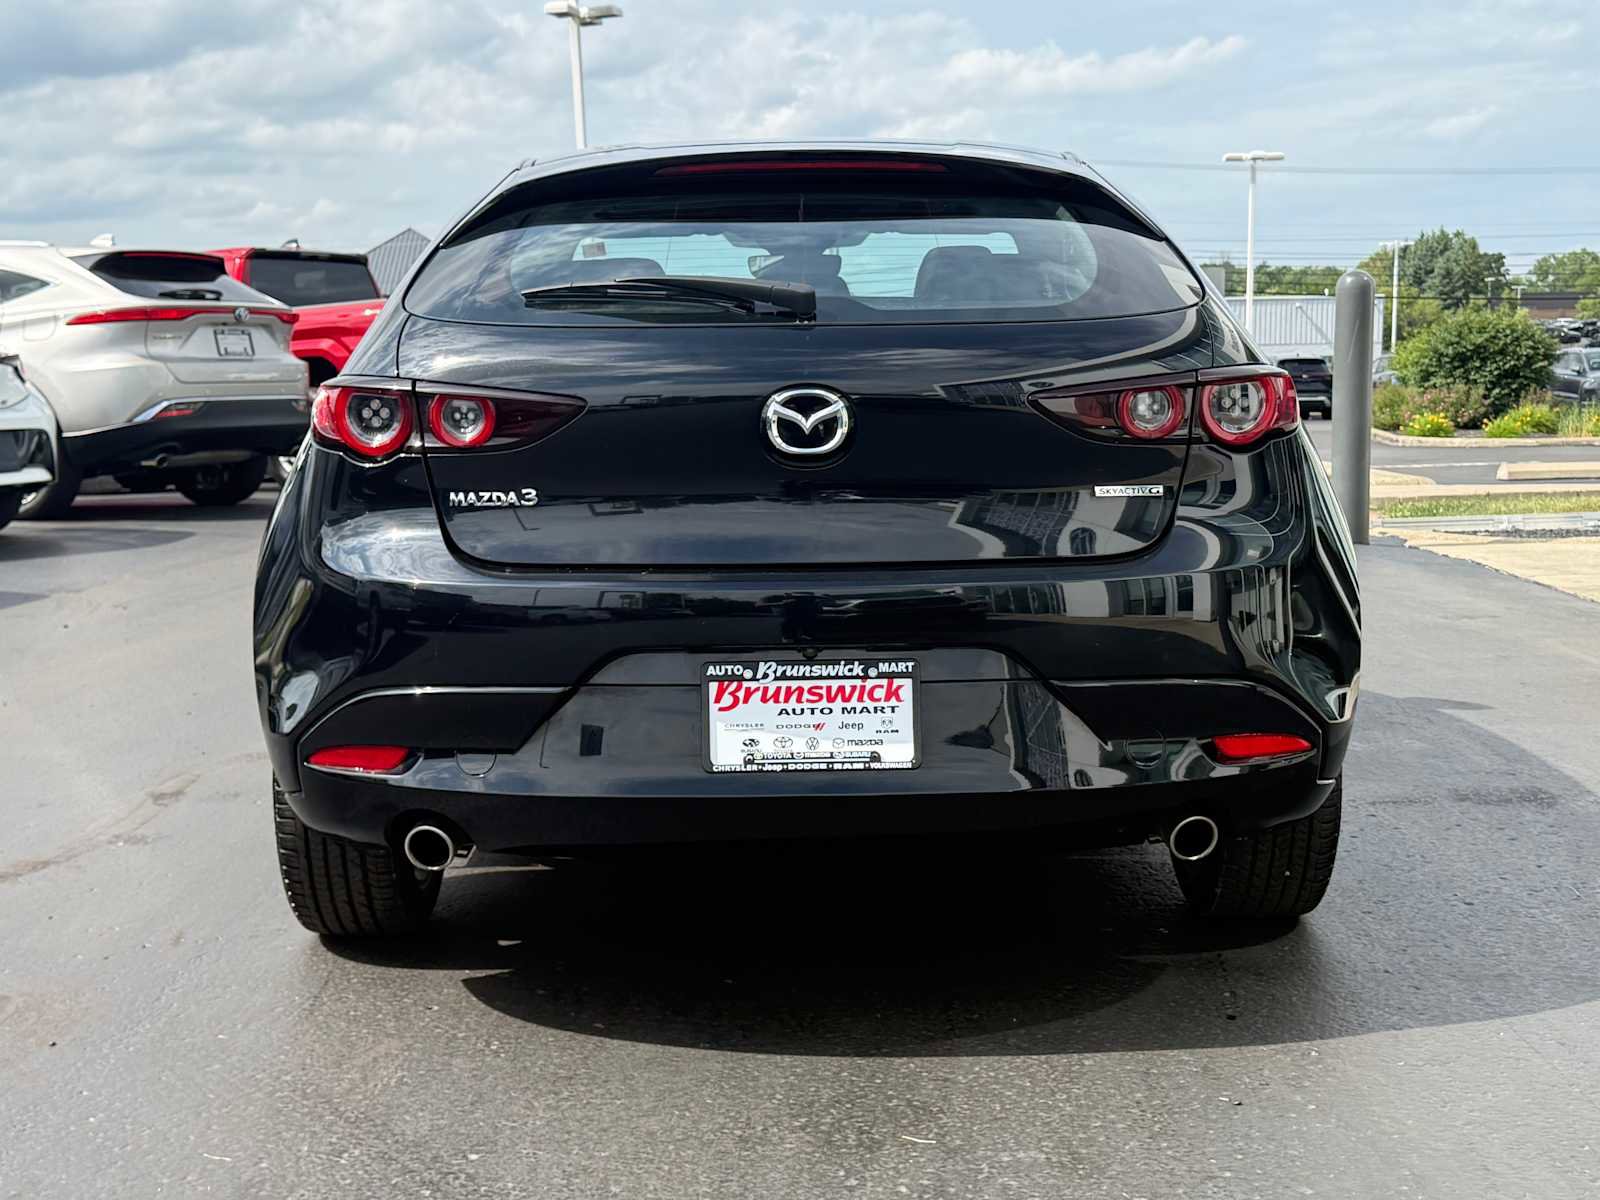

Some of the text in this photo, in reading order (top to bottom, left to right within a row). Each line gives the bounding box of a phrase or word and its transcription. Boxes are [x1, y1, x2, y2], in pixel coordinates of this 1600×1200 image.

[706, 660, 915, 683] AUTO Brunswick MART
[713, 678, 905, 712] Brunswick
[777, 705, 900, 716] AUTO MART
[838, 721, 864, 731] Jeep
